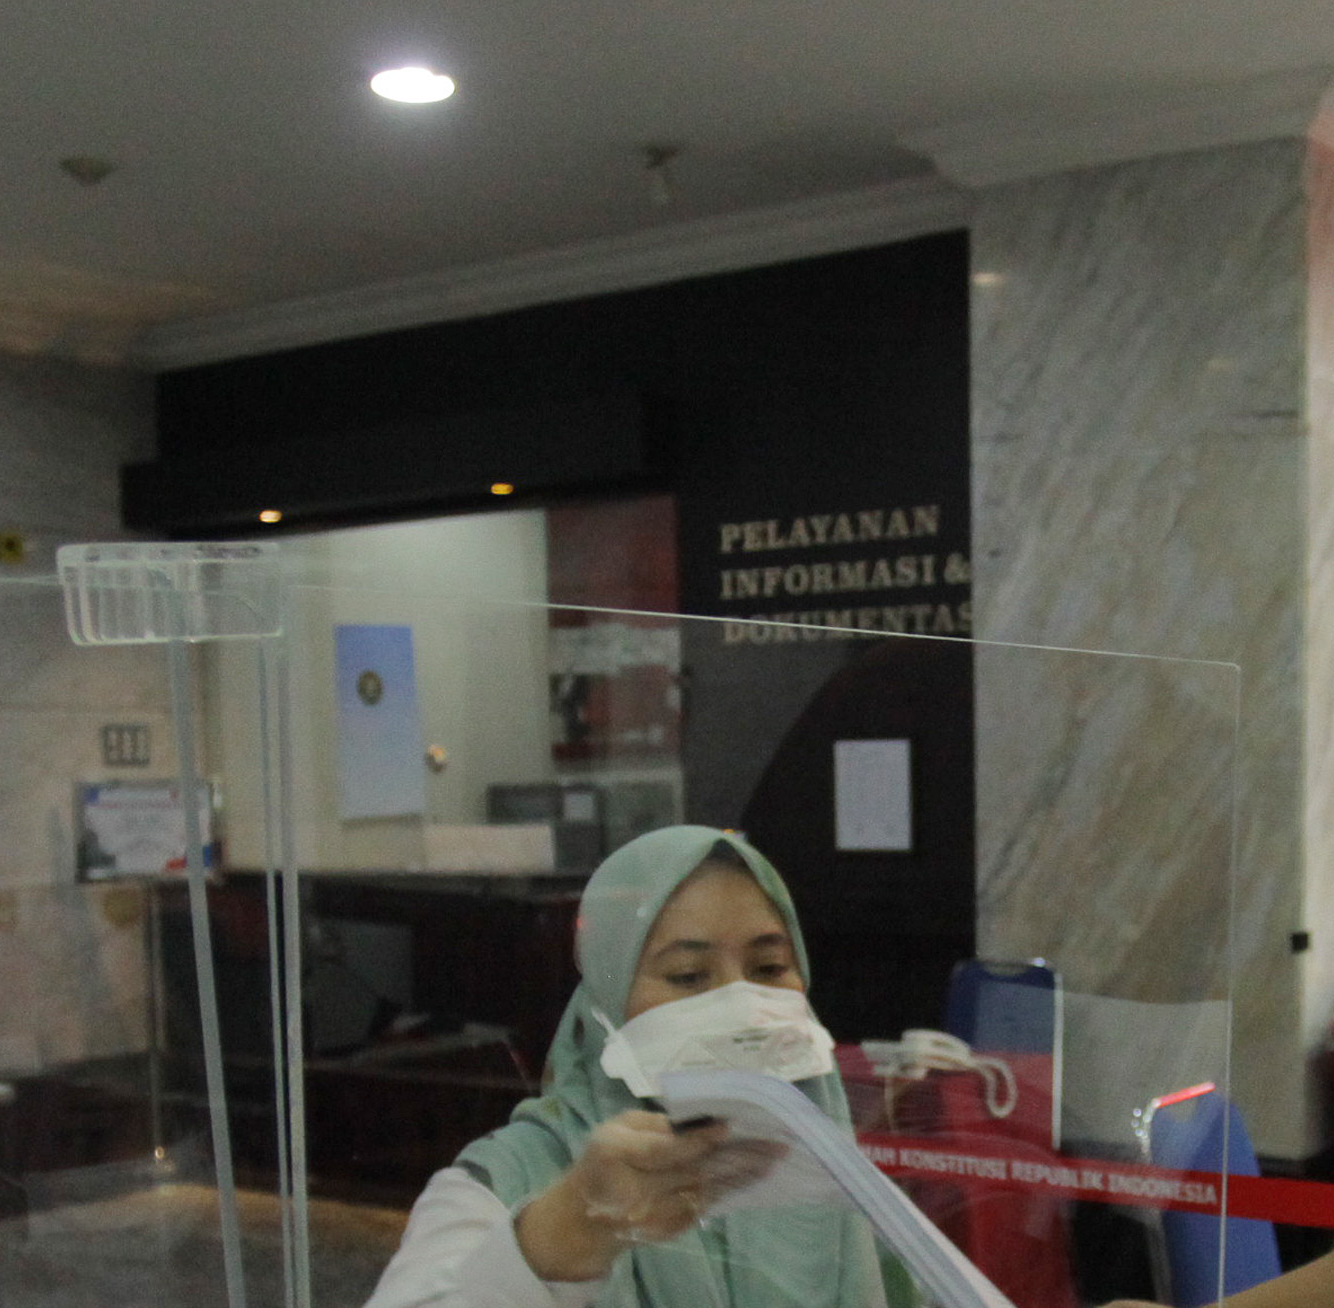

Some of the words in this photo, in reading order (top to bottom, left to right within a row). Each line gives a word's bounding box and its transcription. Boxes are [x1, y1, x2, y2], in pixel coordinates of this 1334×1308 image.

[721, 504, 940, 553] PELAYANAN
[721, 553, 936, 599] INFORMASI
[944, 551, 971, 585] &
[900, 1148, 1006, 1180] KONSTITUSI
[1011, 1159, 1105, 1190] REPUBLIK
[1107, 1172, 1217, 1205] INDONESIA
